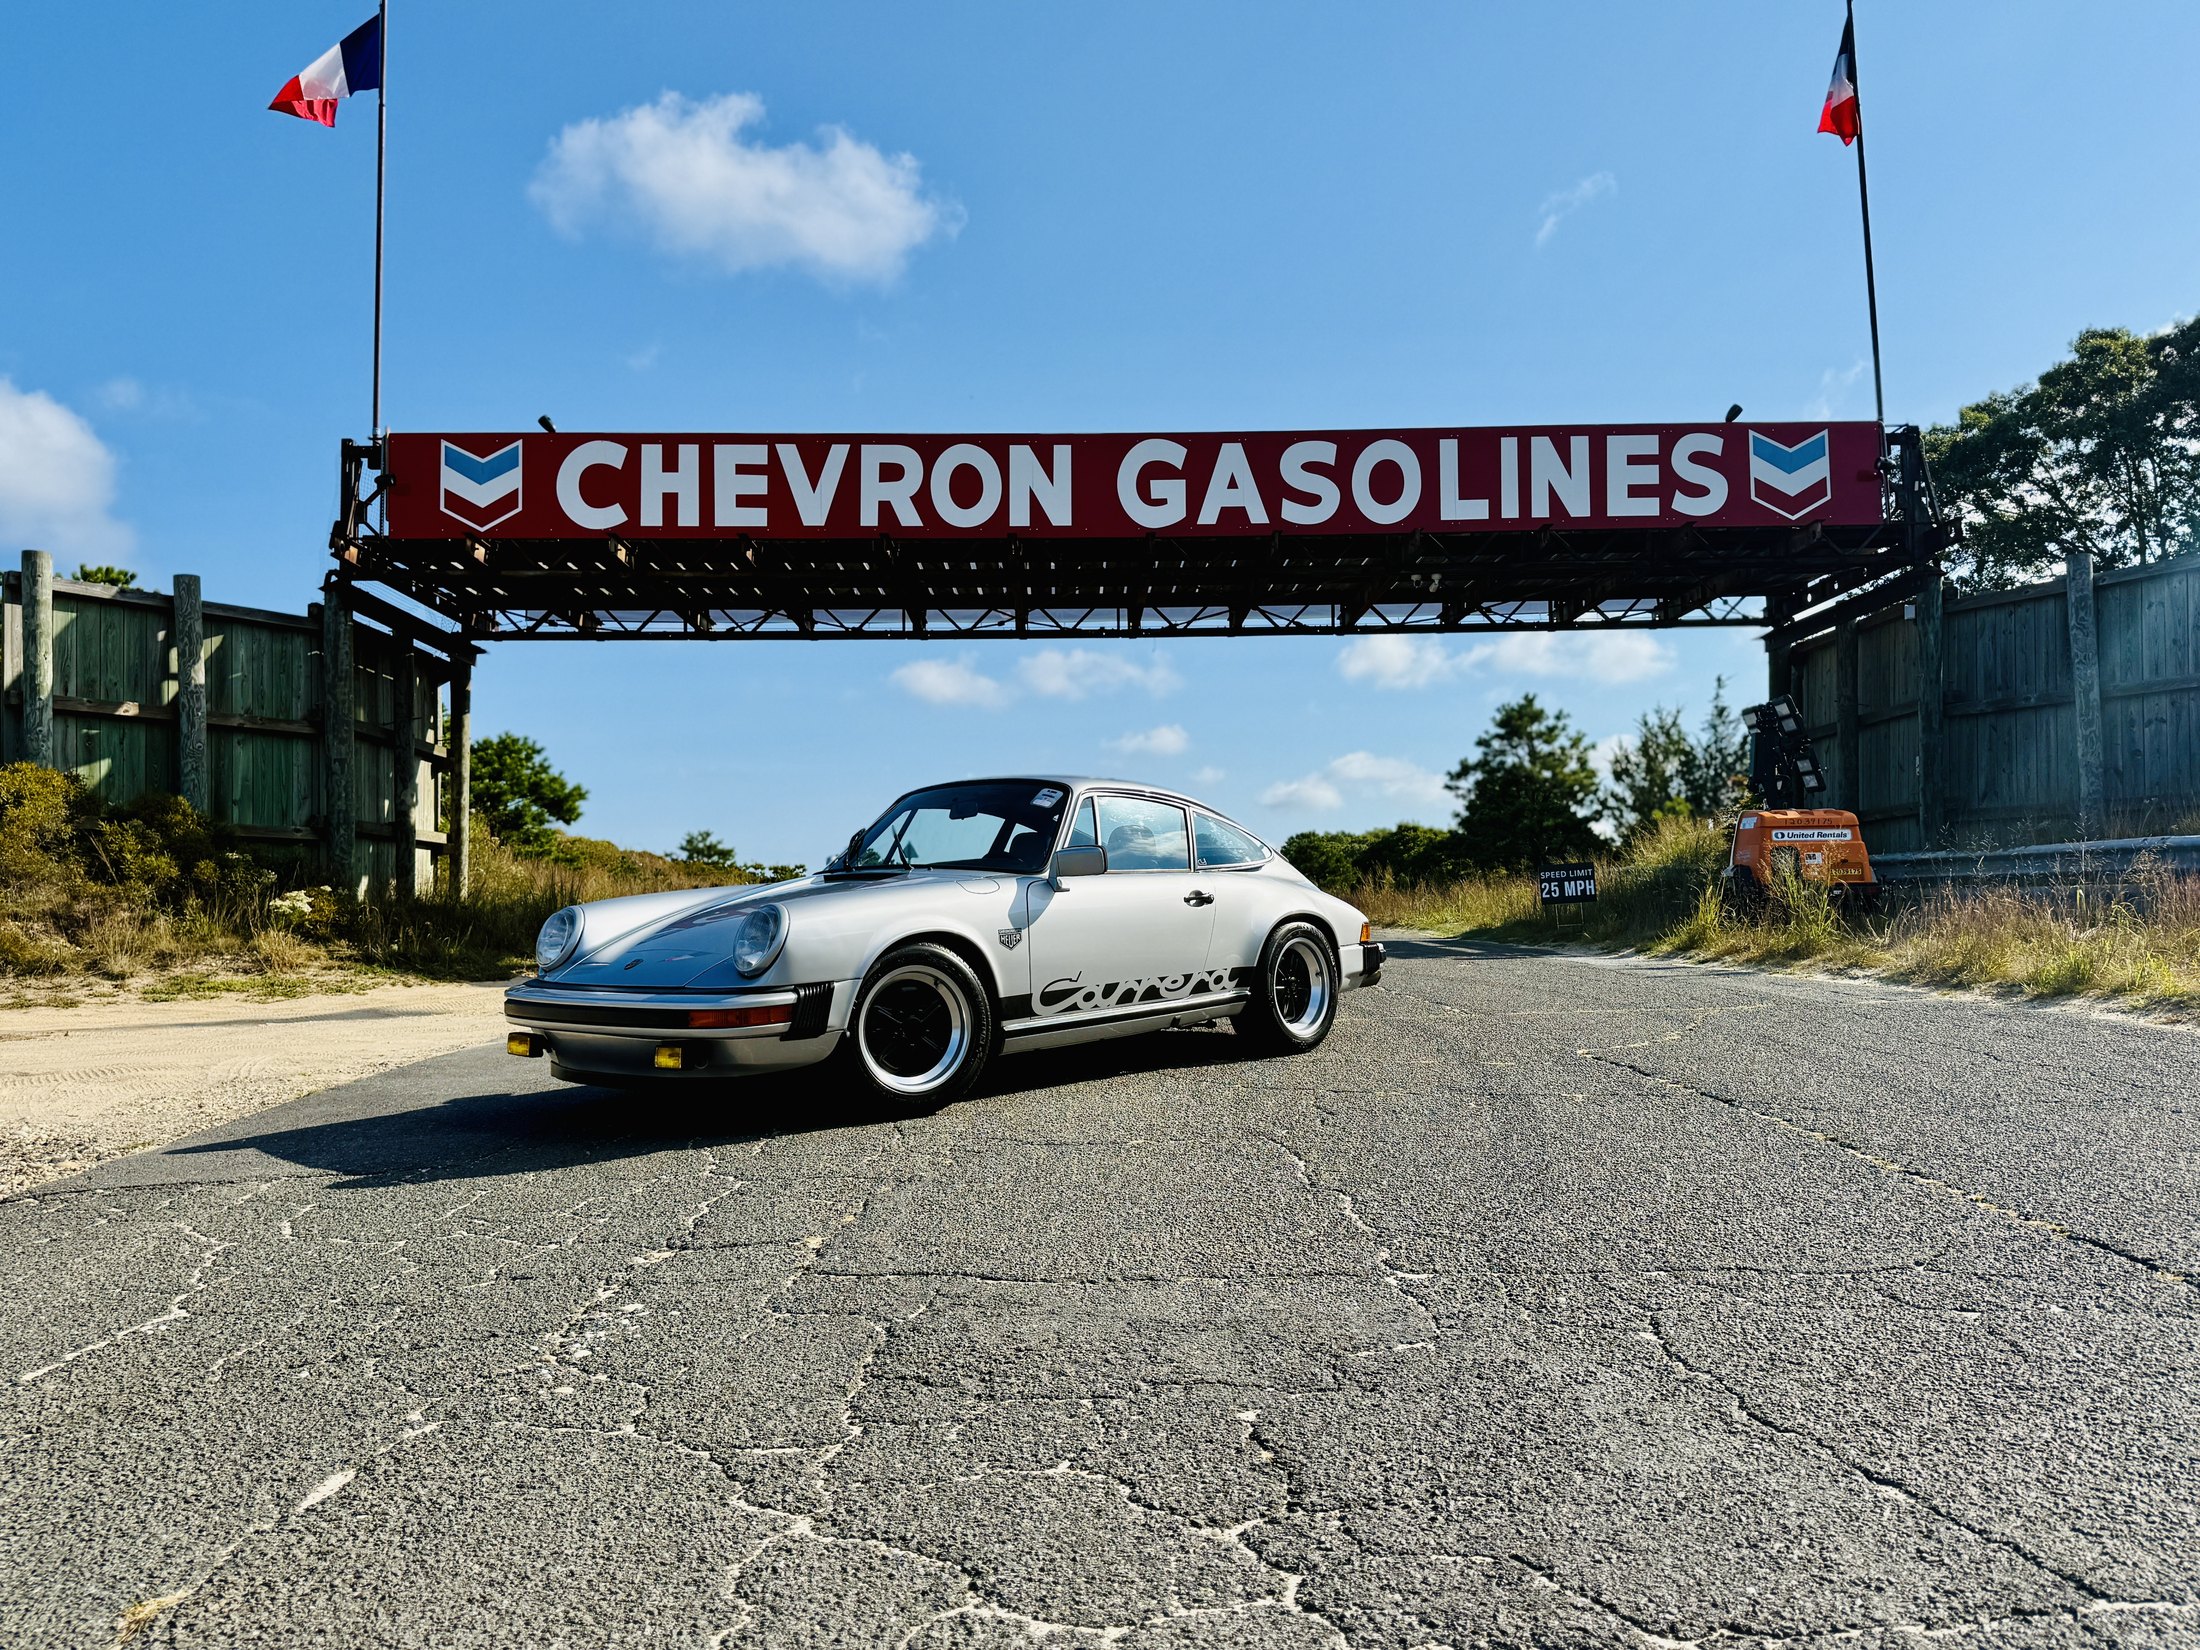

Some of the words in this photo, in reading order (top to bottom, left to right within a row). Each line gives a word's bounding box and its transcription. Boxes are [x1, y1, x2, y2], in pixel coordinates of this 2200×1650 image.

[556, 440, 1072, 530] CHEVRON
[1116, 432, 1729, 529] GASOLINES
[1787, 831, 1815, 839] United
[1816, 831, 1848, 839] Rentals
[1540, 870, 1567, 879] SPEED
[1569, 868, 1593, 877] LIMIT
[1541, 882, 1560, 898] 25
[1564, 879, 1595, 897] MPH
[1000, 933, 1021, 948] HEUER
[1031, 967, 1240, 1016] Carrera
